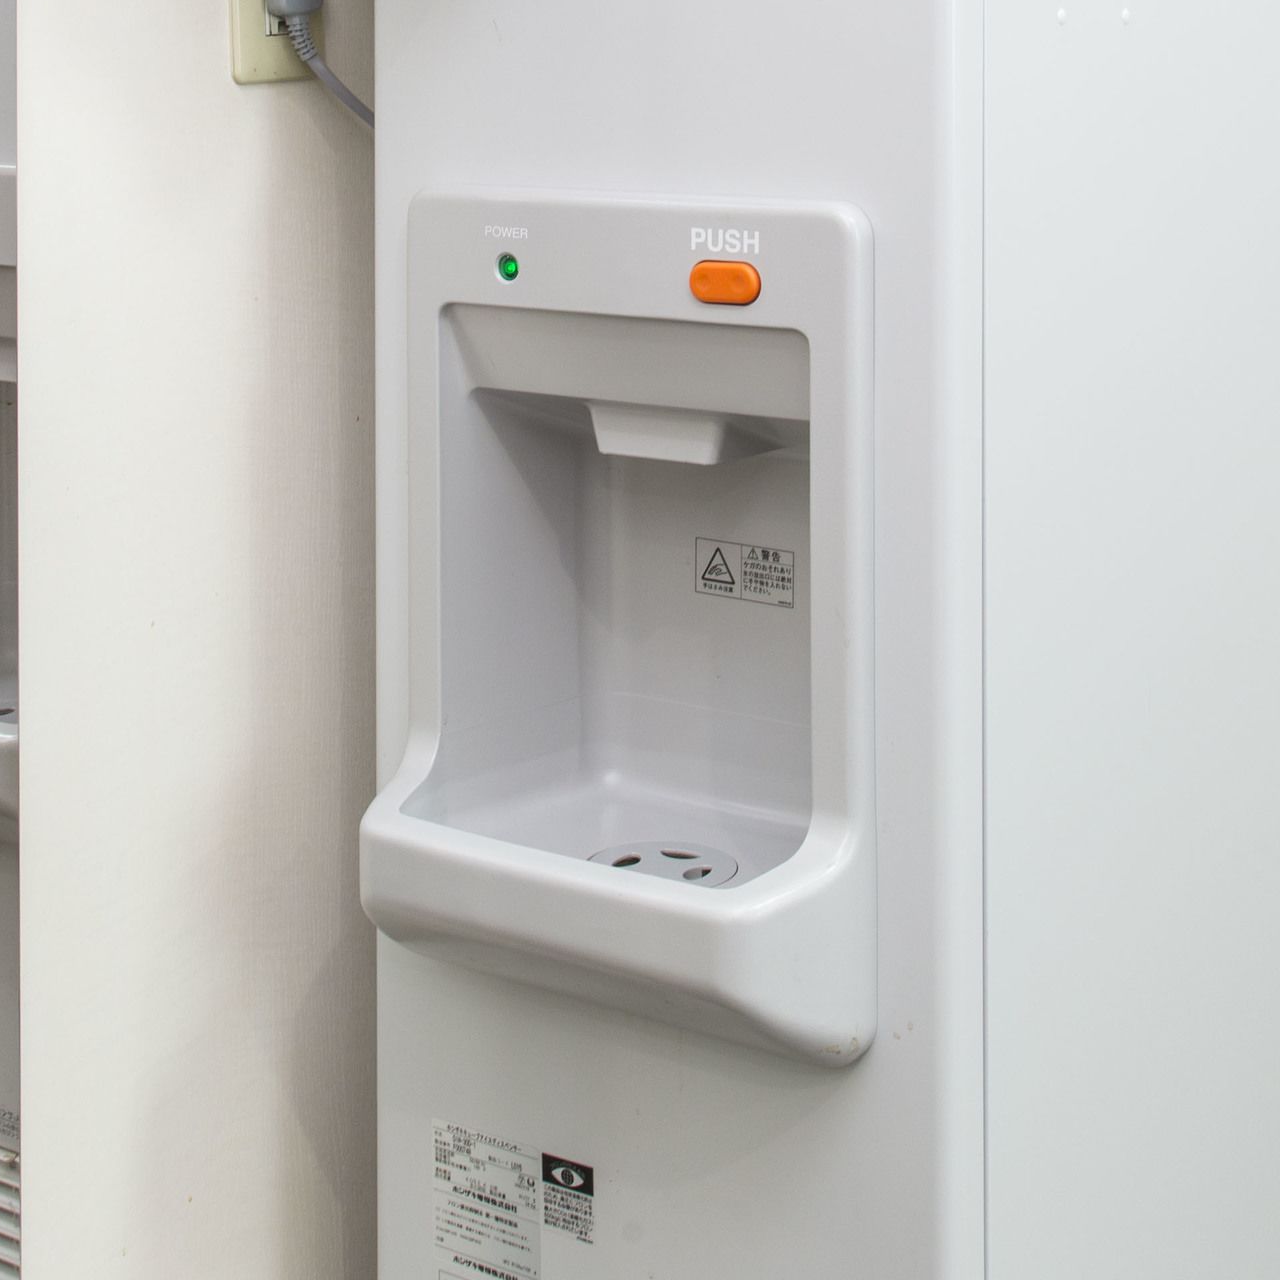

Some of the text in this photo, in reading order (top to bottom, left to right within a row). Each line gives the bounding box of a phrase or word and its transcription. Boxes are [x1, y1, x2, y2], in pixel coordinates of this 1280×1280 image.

[484, 225, 529, 240] POWER
[690, 227, 760, 255] PUSH
[761, 549, 782, 563] 警告
[743, 561, 792, 575] ケガのおそれあり
